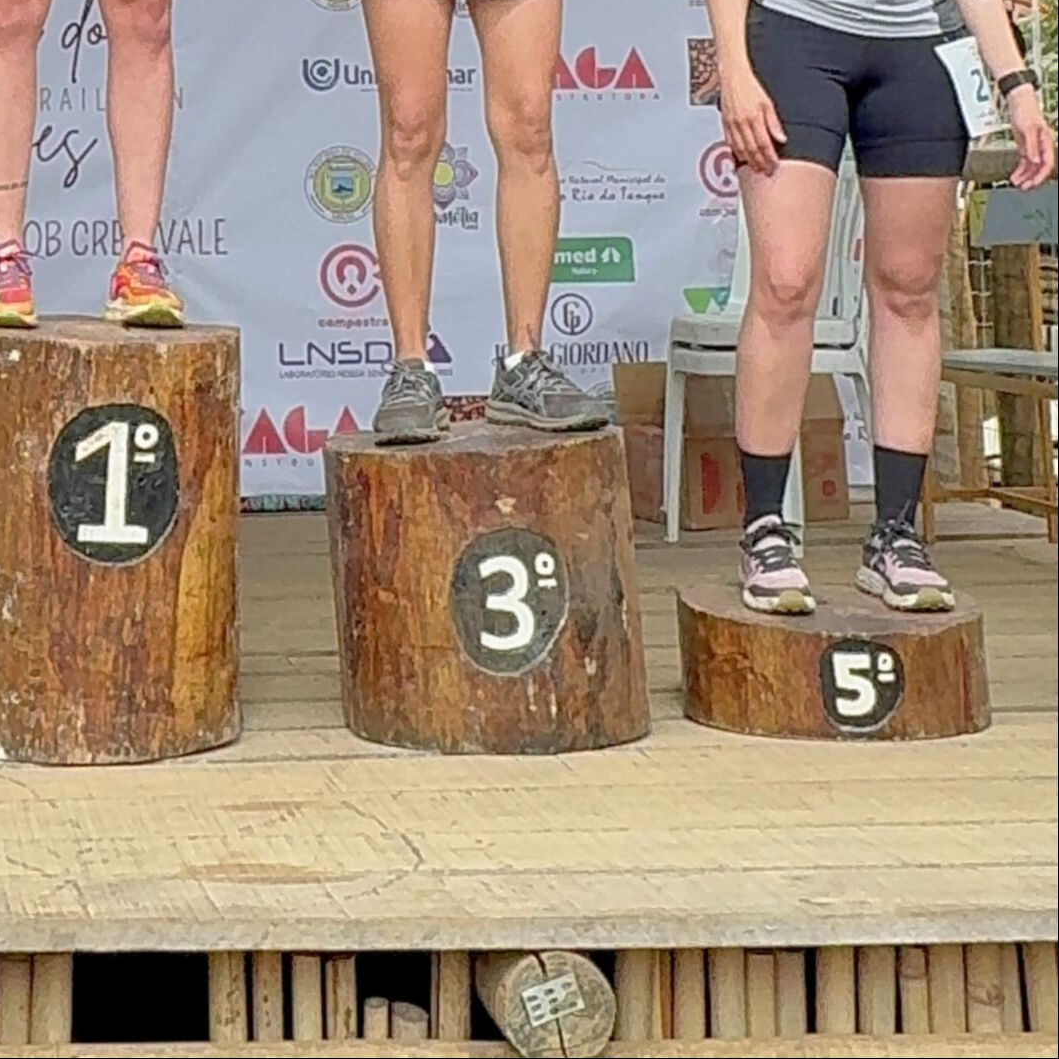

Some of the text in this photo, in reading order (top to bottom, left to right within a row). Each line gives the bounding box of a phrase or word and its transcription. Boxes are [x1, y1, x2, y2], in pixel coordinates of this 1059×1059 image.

[41, 88, 106, 111] RAIL
[571, 188, 595, 203] Rio
[599, 189, 616, 201] do
[619, 187, 665, 205] Tanque
[278, 341, 393, 366] LNSD
[549, 340, 650, 366] GIORDANO
[74, 421, 160, 544] 1º
[477, 552, 557, 651] 3º
[831, 652, 896, 717] 5º
